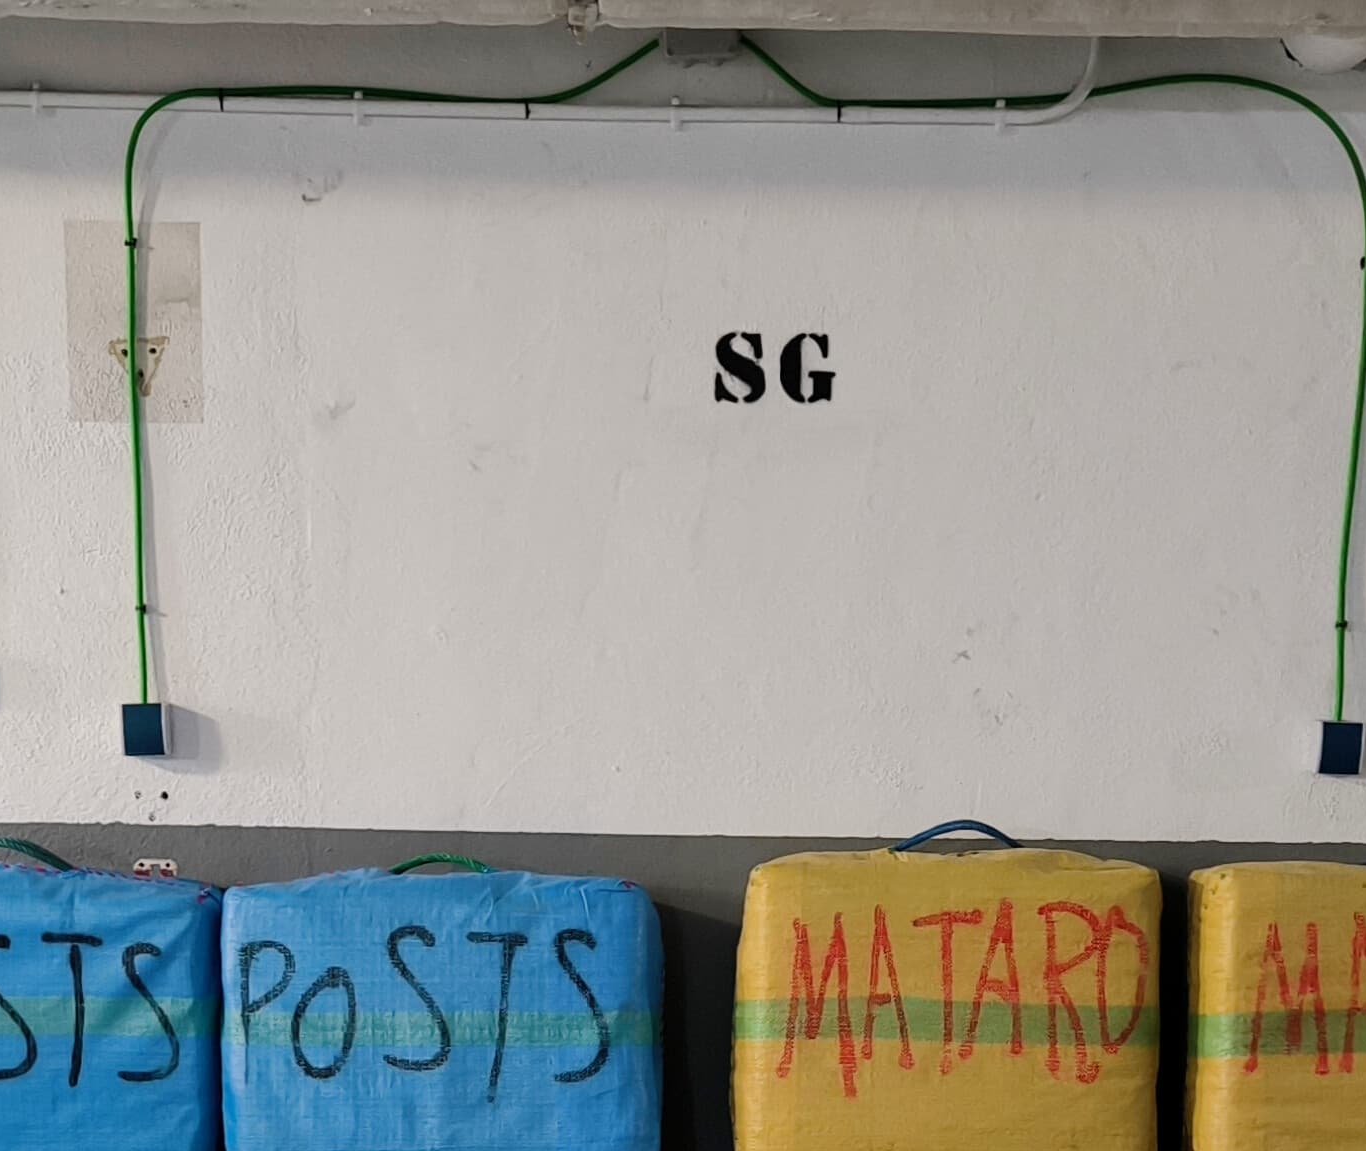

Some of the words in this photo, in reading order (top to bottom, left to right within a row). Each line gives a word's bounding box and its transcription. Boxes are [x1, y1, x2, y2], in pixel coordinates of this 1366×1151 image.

[714, 331, 836, 404] SG
[239, 925, 613, 1103] POSTS
[775, 897, 1151, 1100] MATARO
